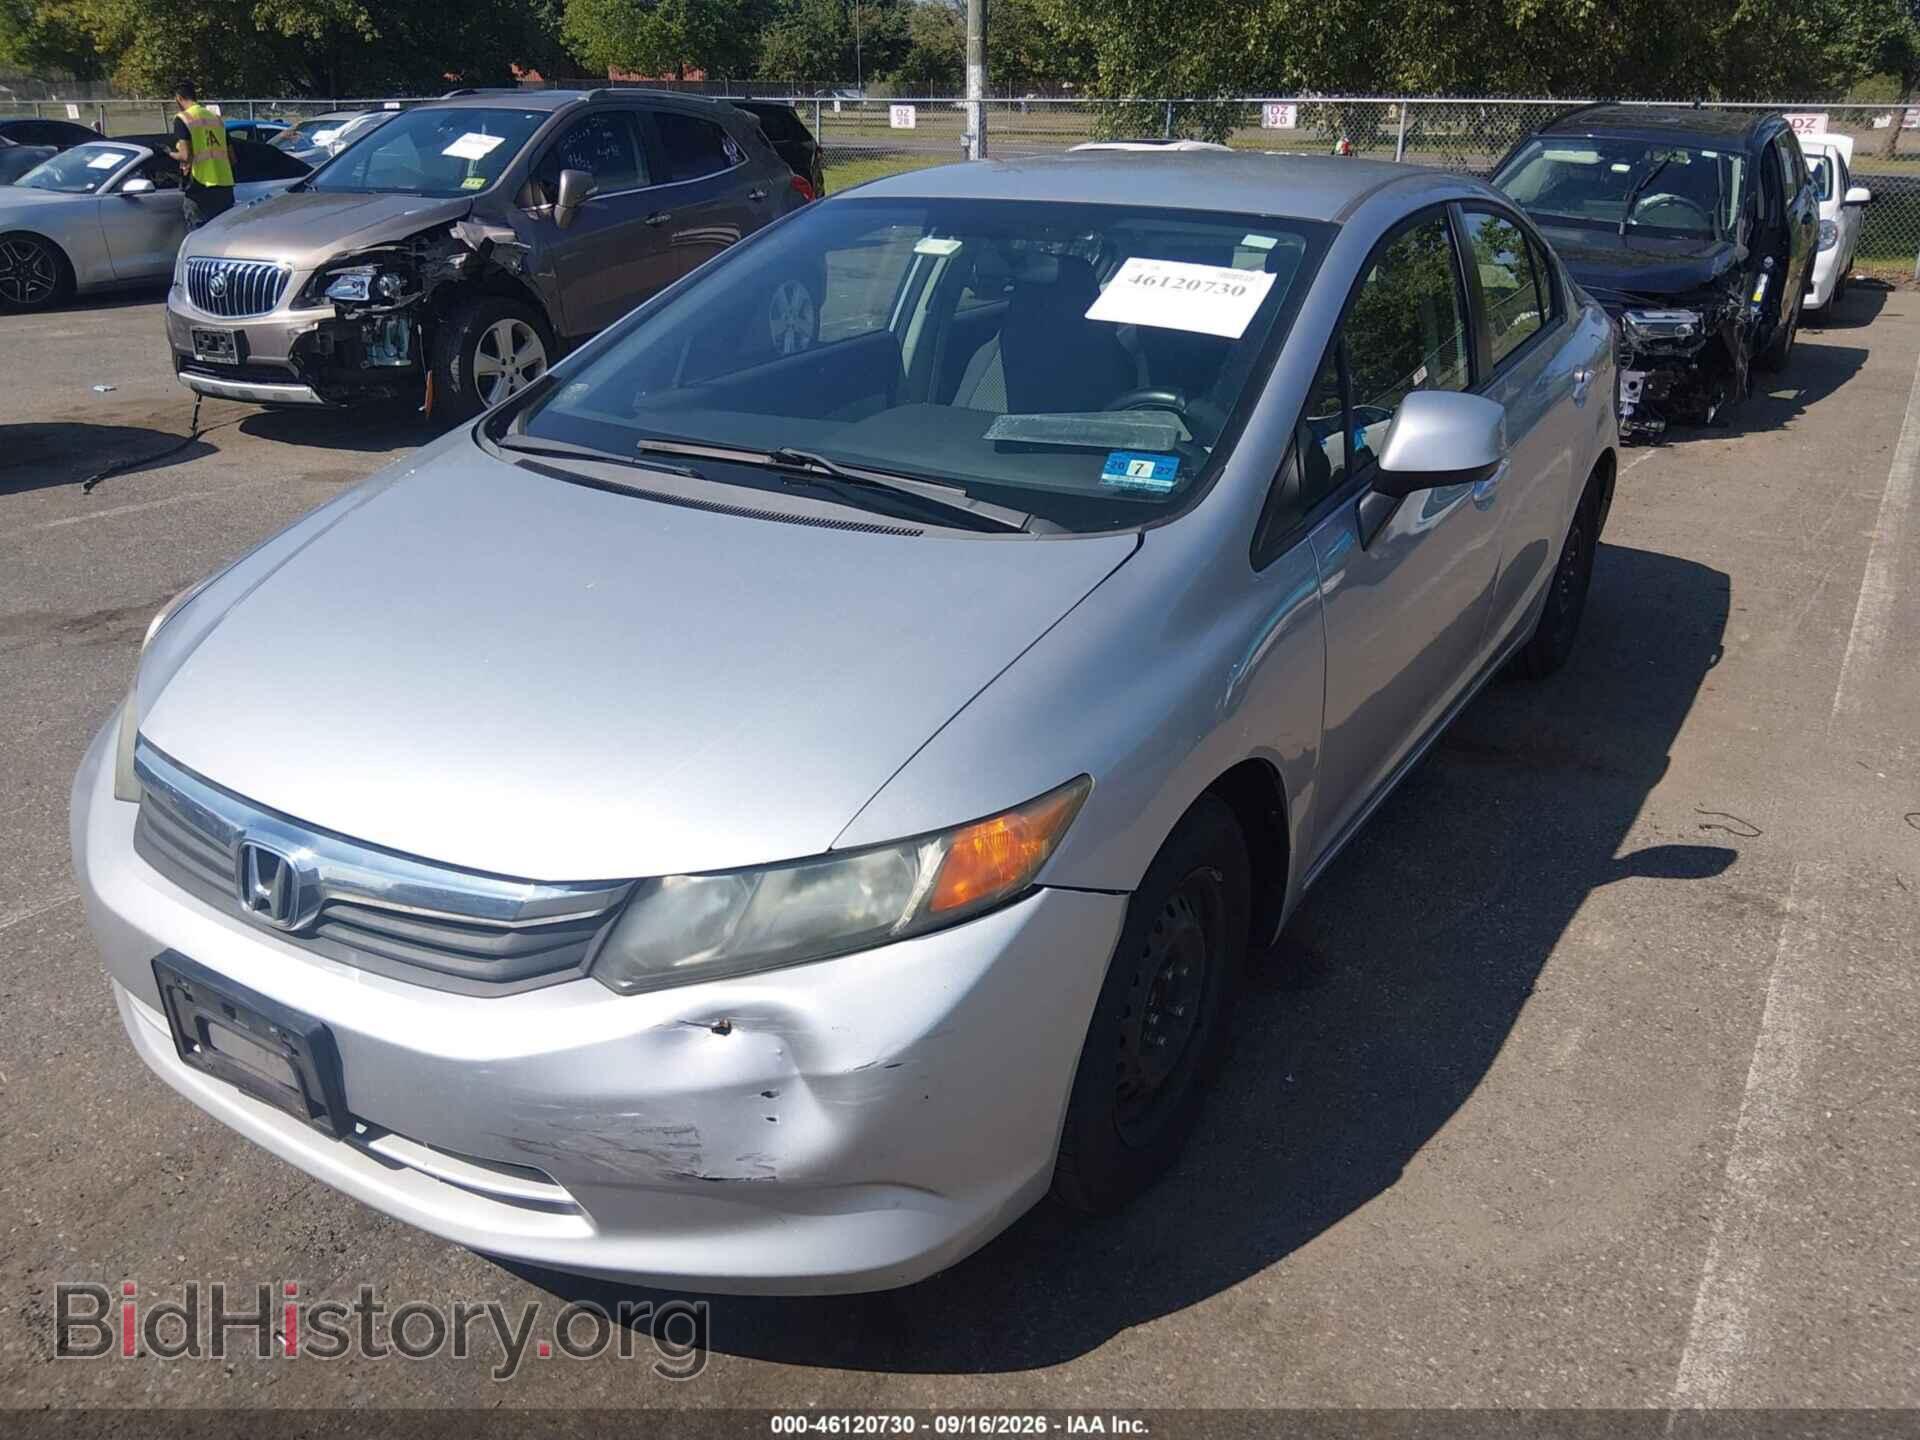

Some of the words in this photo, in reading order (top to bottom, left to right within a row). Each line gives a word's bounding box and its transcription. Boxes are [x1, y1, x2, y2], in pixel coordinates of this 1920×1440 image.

[1271, 104, 1288, 115] DZ
[1272, 115, 1287, 125] 30
[1792, 117, 1816, 128] DZ
[1128, 272, 1246, 297] 46120730
[1134, 462, 1144, 475] 7
